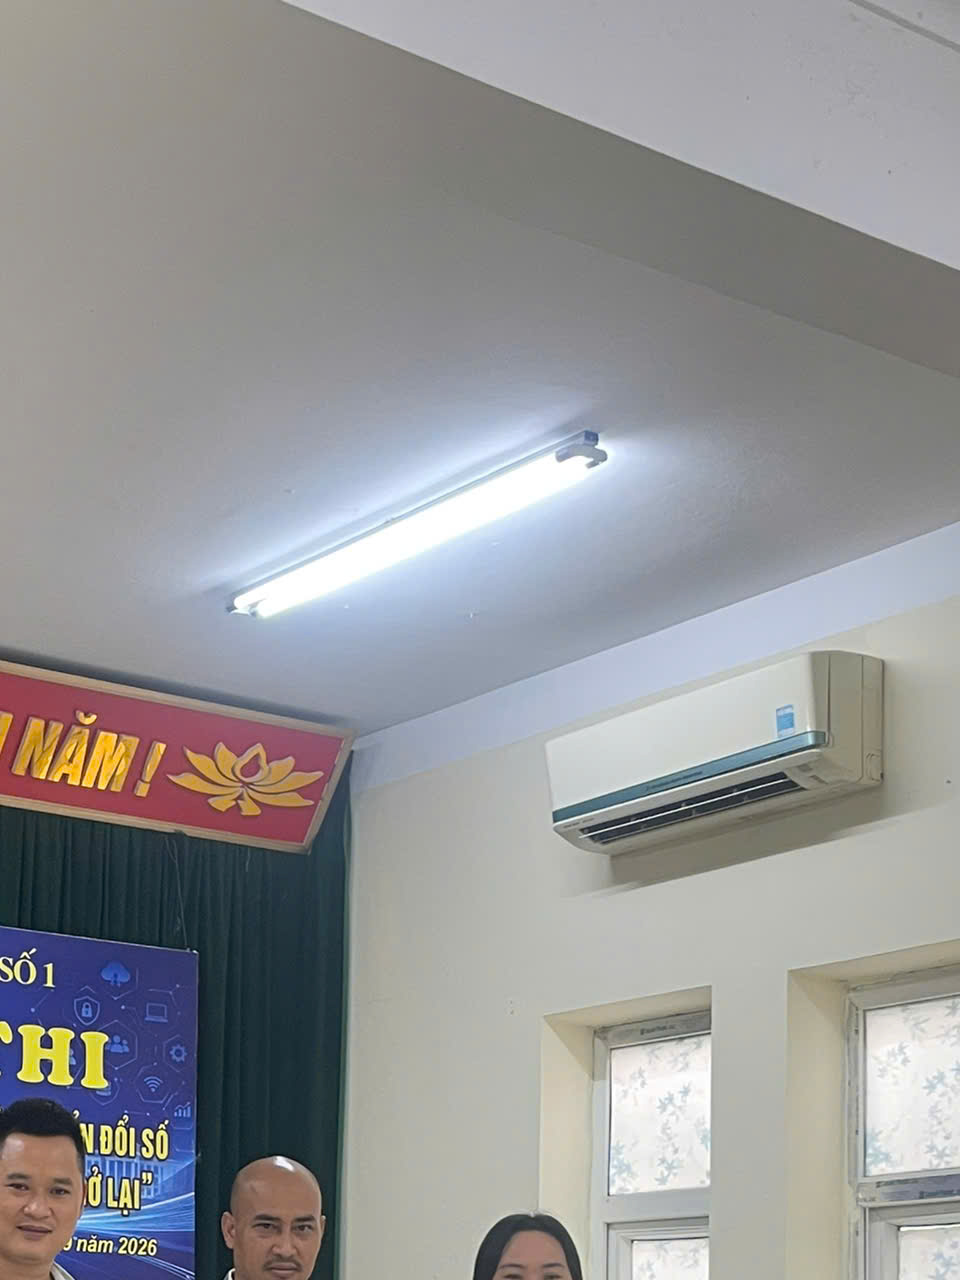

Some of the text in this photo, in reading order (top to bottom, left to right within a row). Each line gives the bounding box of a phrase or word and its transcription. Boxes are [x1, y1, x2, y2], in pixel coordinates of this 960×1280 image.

[11, 709, 140, 794] NĂM
[43, 962, 56, 988] 1
[98, 1114, 136, 1157] ĐỔI
[141, 1119, 170, 1160] SỐ
[76, 1234, 114, 1253] năm
[117, 1237, 158, 1256] 2026
